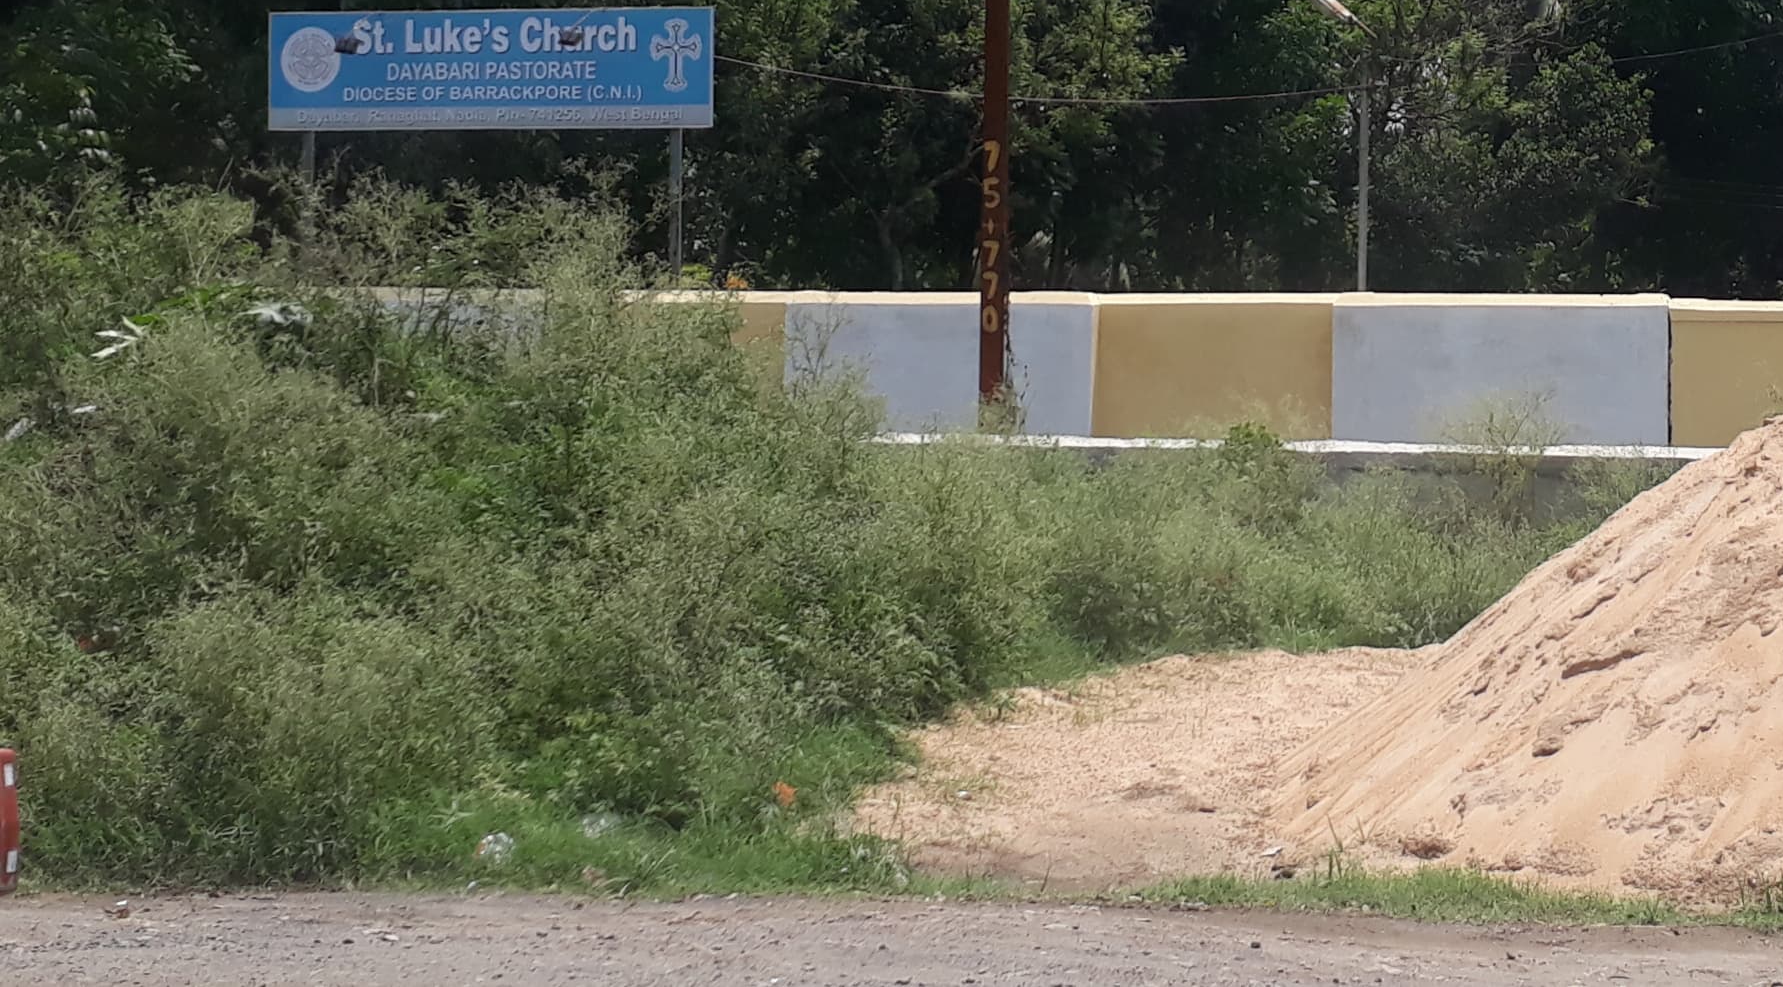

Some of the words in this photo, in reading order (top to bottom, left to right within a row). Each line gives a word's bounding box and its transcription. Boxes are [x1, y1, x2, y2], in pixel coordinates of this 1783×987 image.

[353, 17, 394, 55] St.
[387, 62, 480, 81] DAYABARI
[486, 60, 597, 80] PASTORATE
[343, 86, 417, 102] DIOCESE
[422, 86, 445, 101] OF
[450, 85, 581, 100] BARRACKPORE
[587, 84, 642, 101] (C.N.I.)
